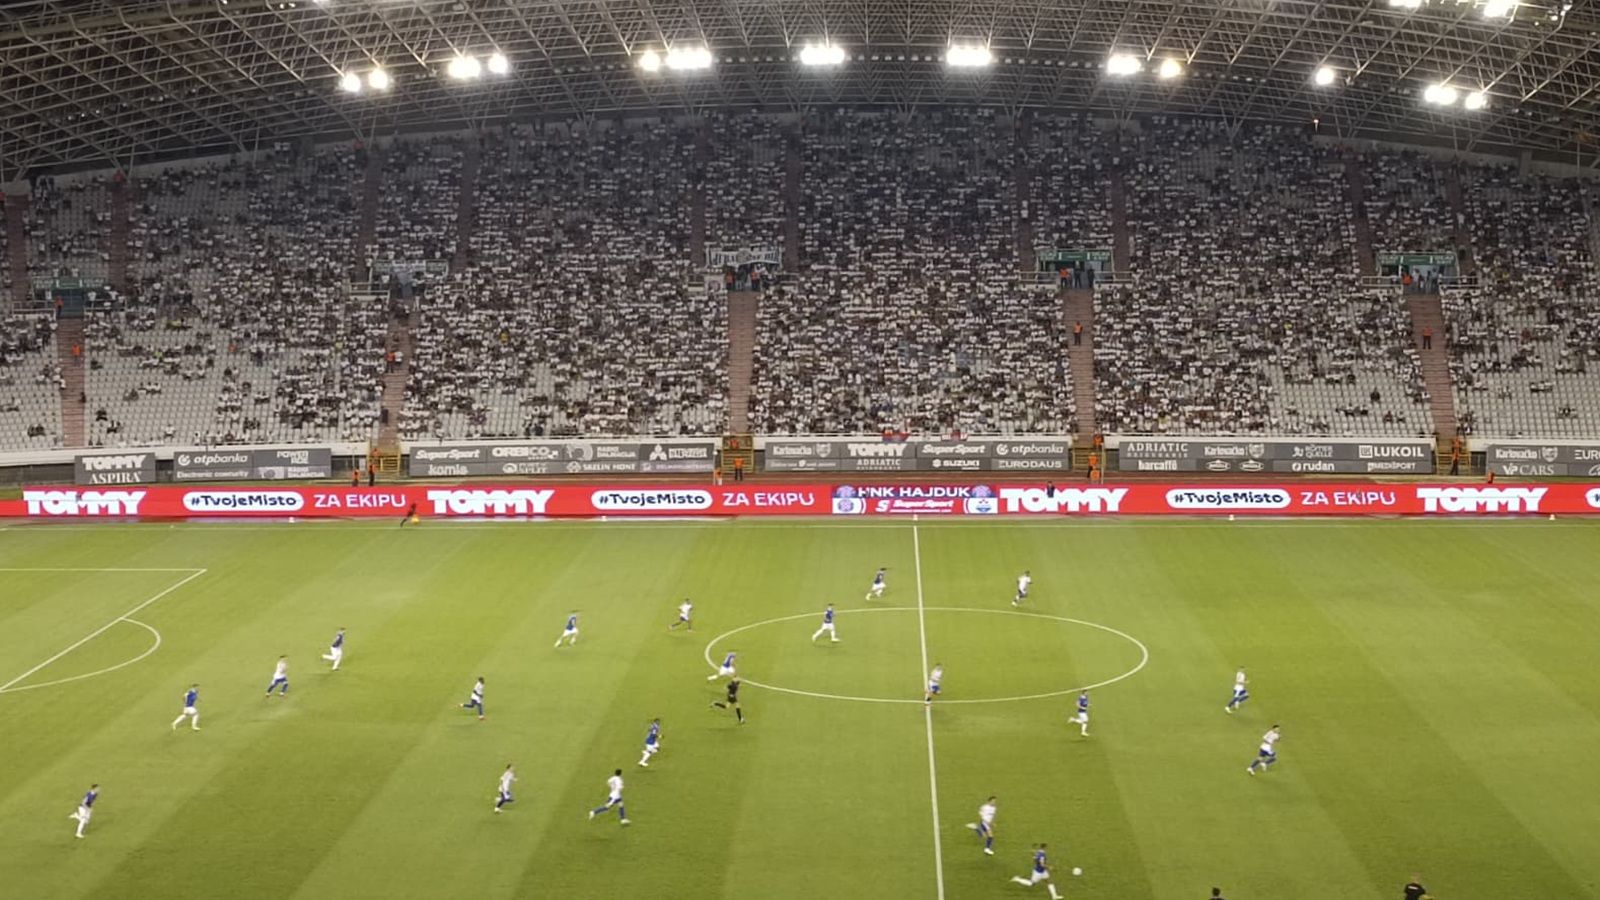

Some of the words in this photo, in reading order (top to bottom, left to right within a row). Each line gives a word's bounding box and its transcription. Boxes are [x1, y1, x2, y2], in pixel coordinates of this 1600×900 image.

[492, 446, 550, 457] ORBICO
[847, 443, 907, 456] TOMMY
[922, 444, 985, 455] SuperSport
[1011, 444, 1064, 455] otpbanka
[1127, 443, 1188, 452] ADRIATIC
[1374, 446, 1424, 457] LUKOIL
[194, 453, 248, 466] otpbanka
[415, 449, 480, 460] SuperSport
[82, 455, 146, 470] TOMMY
[1303, 460, 1335, 471] rudan
[1520, 465, 1555, 475] CARS
[89, 472, 141, 484] ASPIRA
[858, 487, 895, 497] HNK
[899, 487, 970, 497] HAJDUK
[1174, 491, 1284, 505] #TvojeMisto
[1301, 492, 1329, 505] ZA
[1333, 492, 1396, 505] EKIPU
[23, 491, 147, 515] TOMMY
[191, 494, 297, 508] #TvojeMisto
[314, 494, 341, 508] ZA
[345, 494, 406, 508] EKIPU
[427, 490, 555, 514] TOMMY
[599, 493, 706, 507] #TvojeMisto
[722, 493, 750, 506] ZA
[754, 493, 814, 506] EKIPU
[893, 500, 954, 508] SuperSport
[1000, 488, 1128, 512] TOMMY
[1416, 487, 1548, 512] TOMMY
